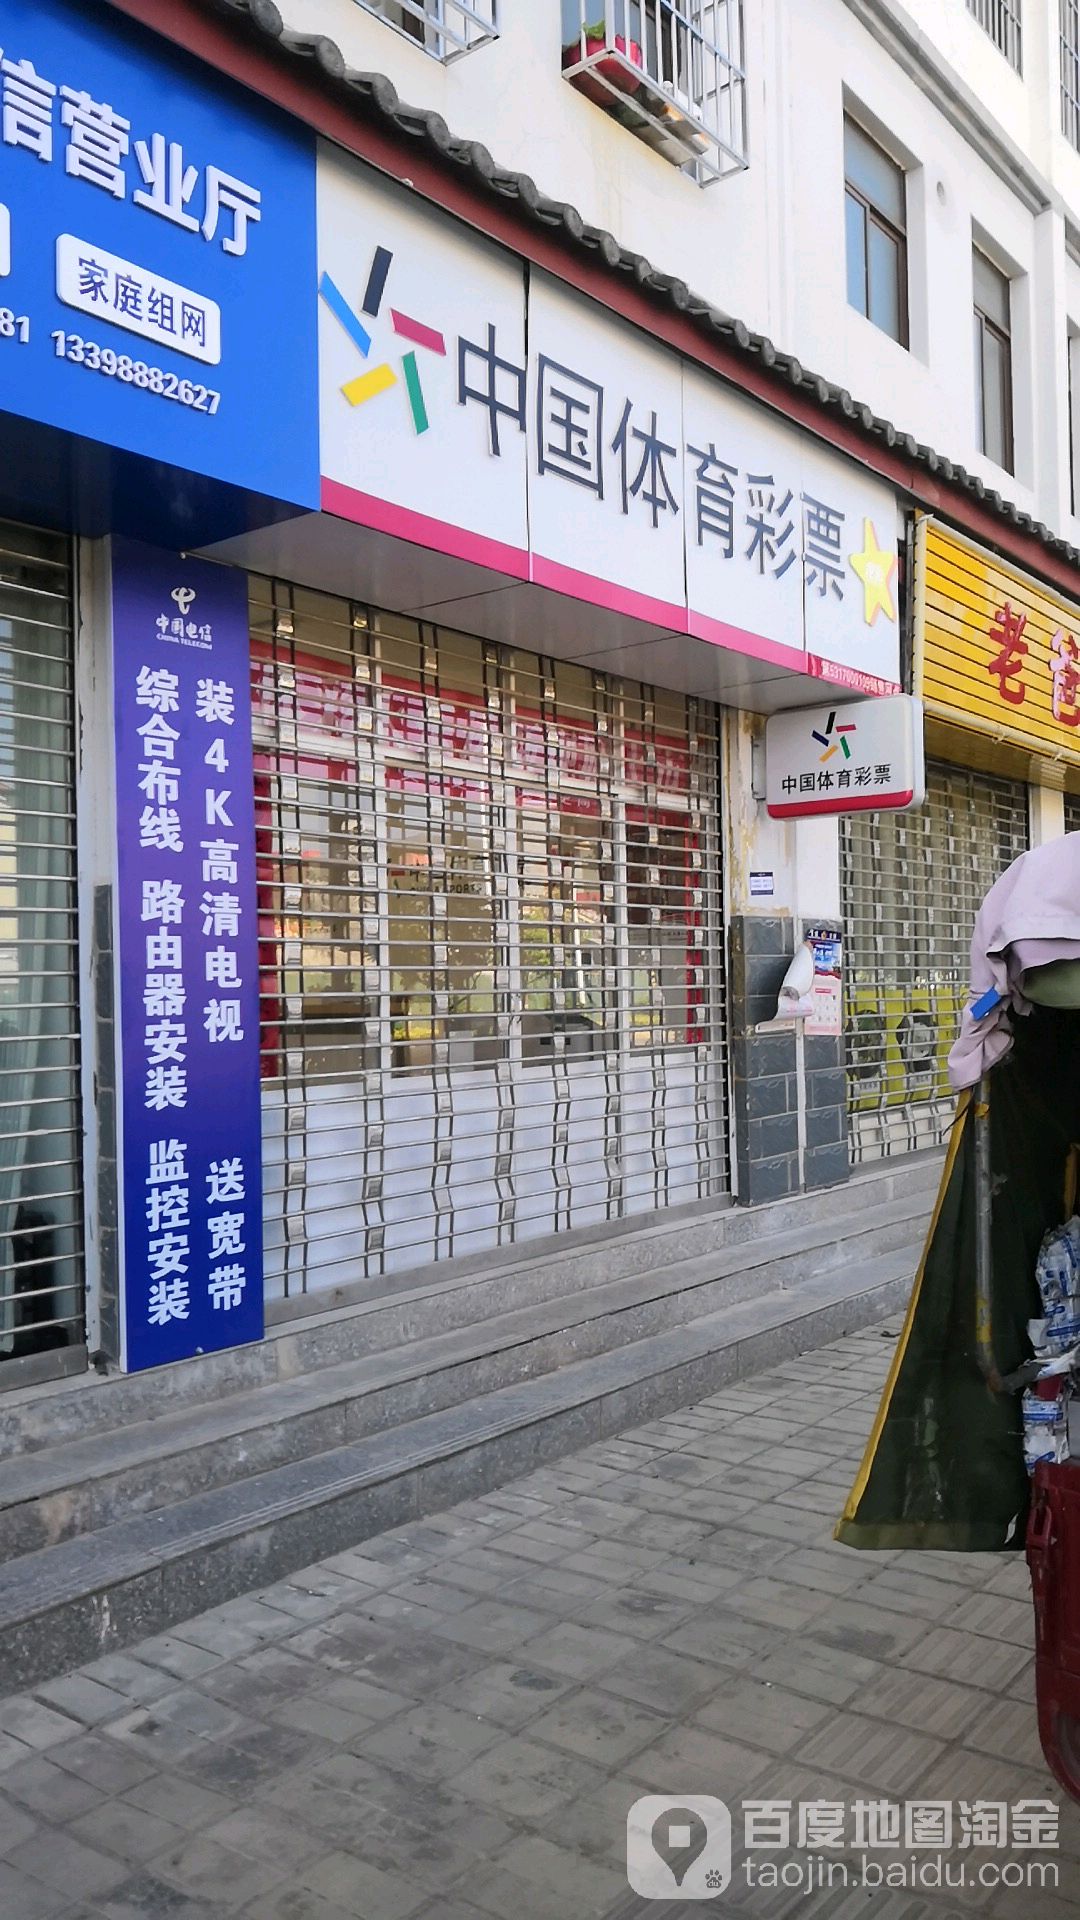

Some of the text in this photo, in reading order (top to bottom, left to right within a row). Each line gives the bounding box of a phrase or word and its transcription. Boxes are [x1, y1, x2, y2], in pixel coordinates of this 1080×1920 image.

[78, 256, 205, 347] 家庭组网
[51, 330, 221, 415] 13398882627
[458, 323, 846, 601] 中国体育彩票
[156, 612, 212, 642] 中国电信
[782, 764, 891, 795] 中国体育彩票
[135, 665, 190, 1326] 综合布线 路由器安装 监控安装
[195, 678, 247, 1311] 装4K高清电视 送宽带
